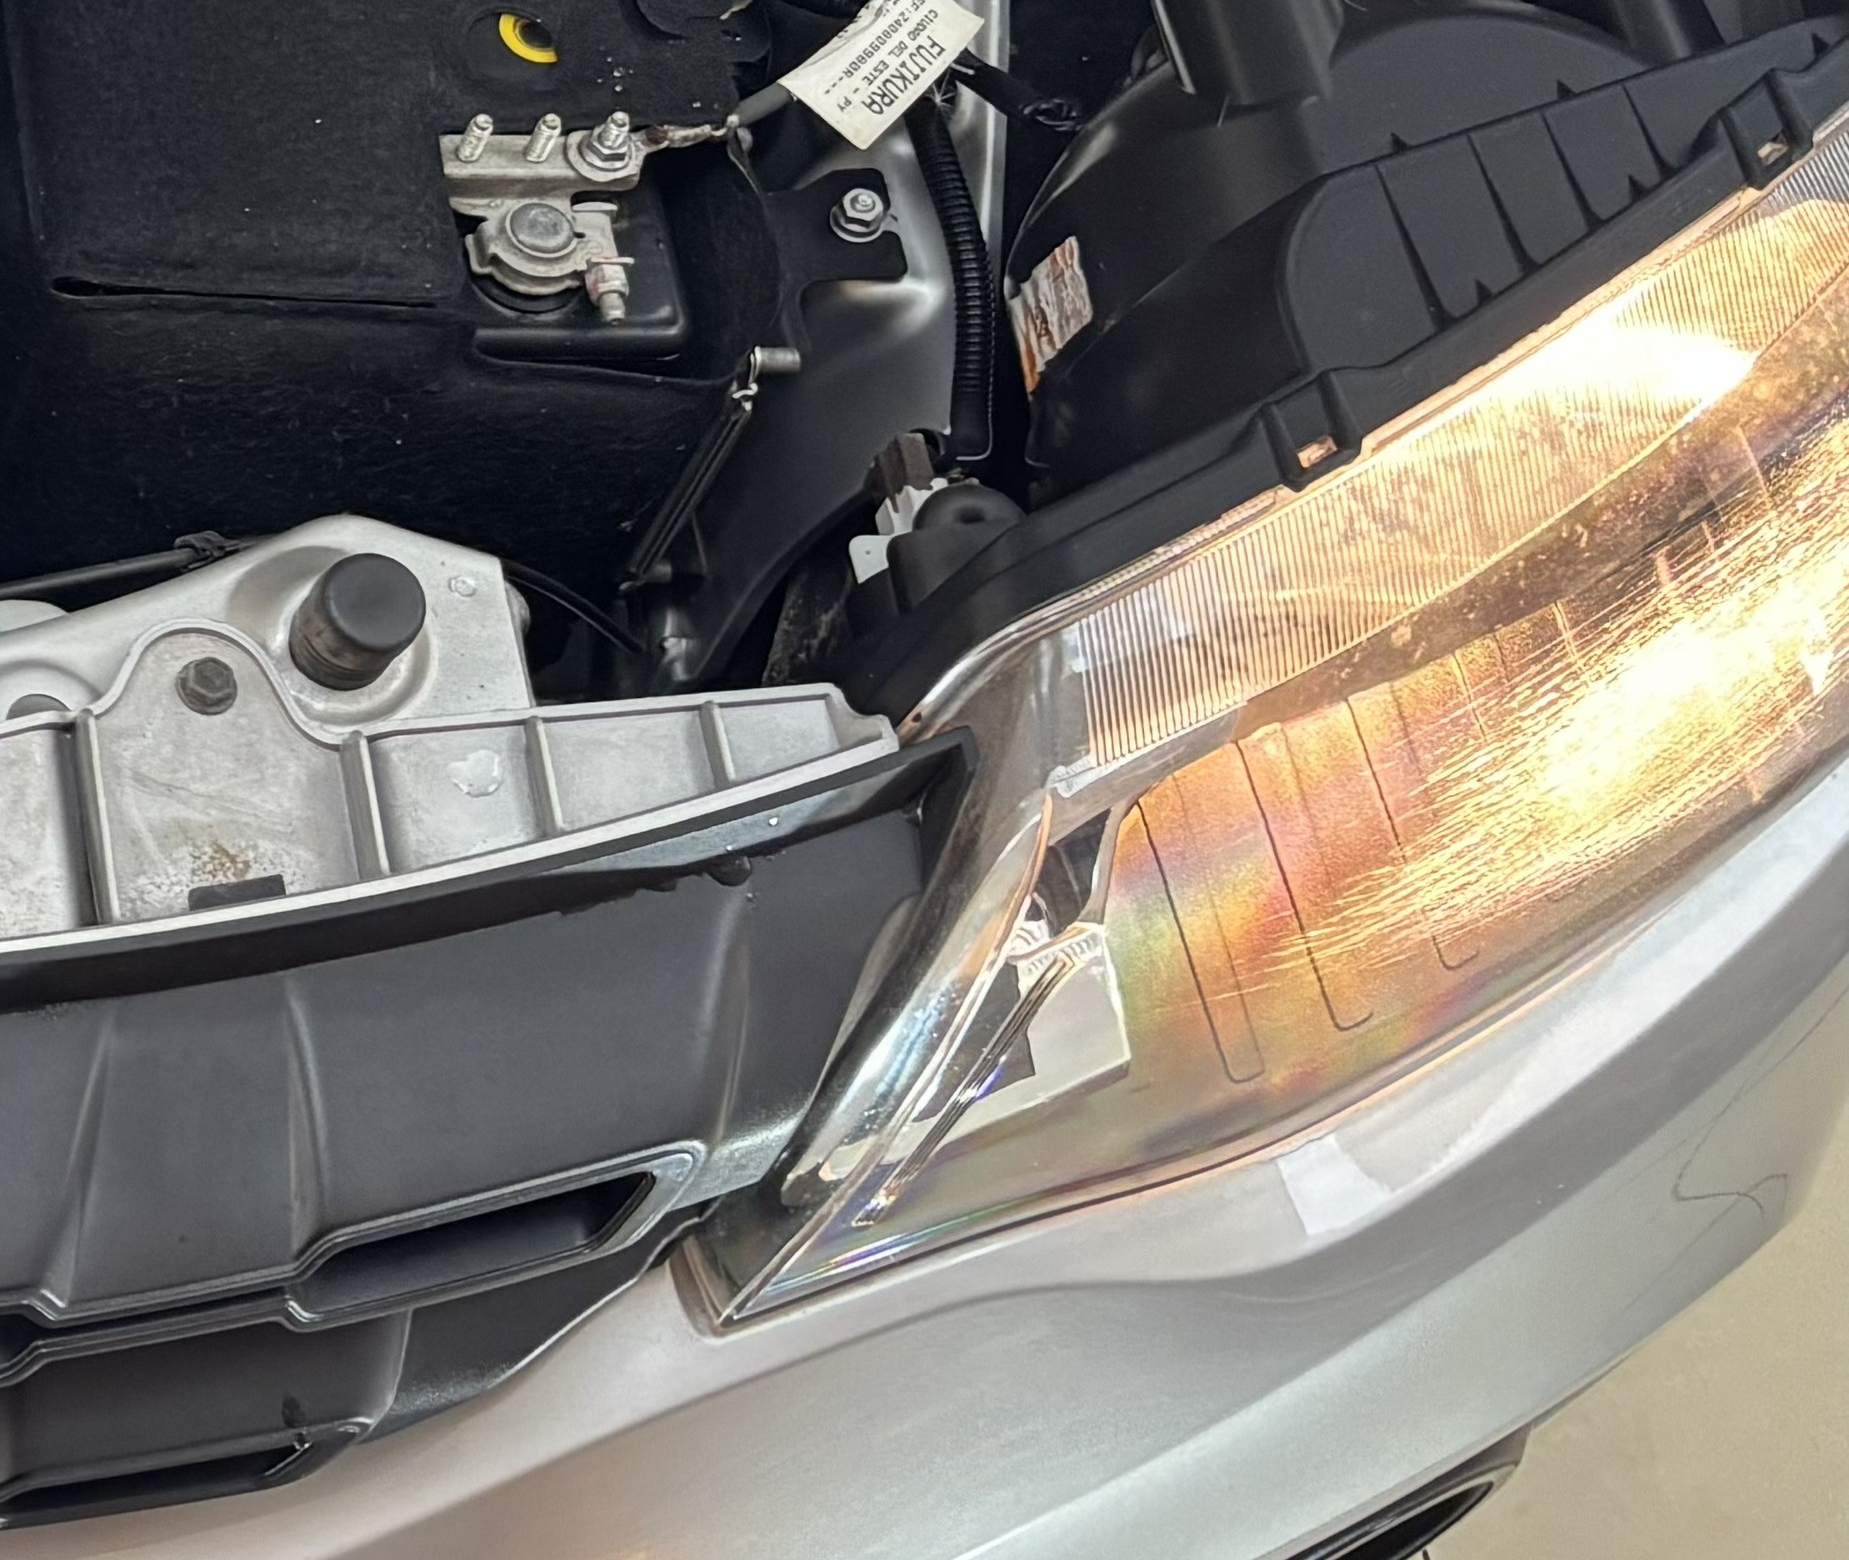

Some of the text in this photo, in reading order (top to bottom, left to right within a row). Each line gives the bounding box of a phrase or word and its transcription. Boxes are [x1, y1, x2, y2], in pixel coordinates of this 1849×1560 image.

[887, 40, 907, 60] DEL
[860, 34, 945, 118] FUJIKURA
[861, 59, 888, 86] ESTE
[835, 95, 851, 112] PY
